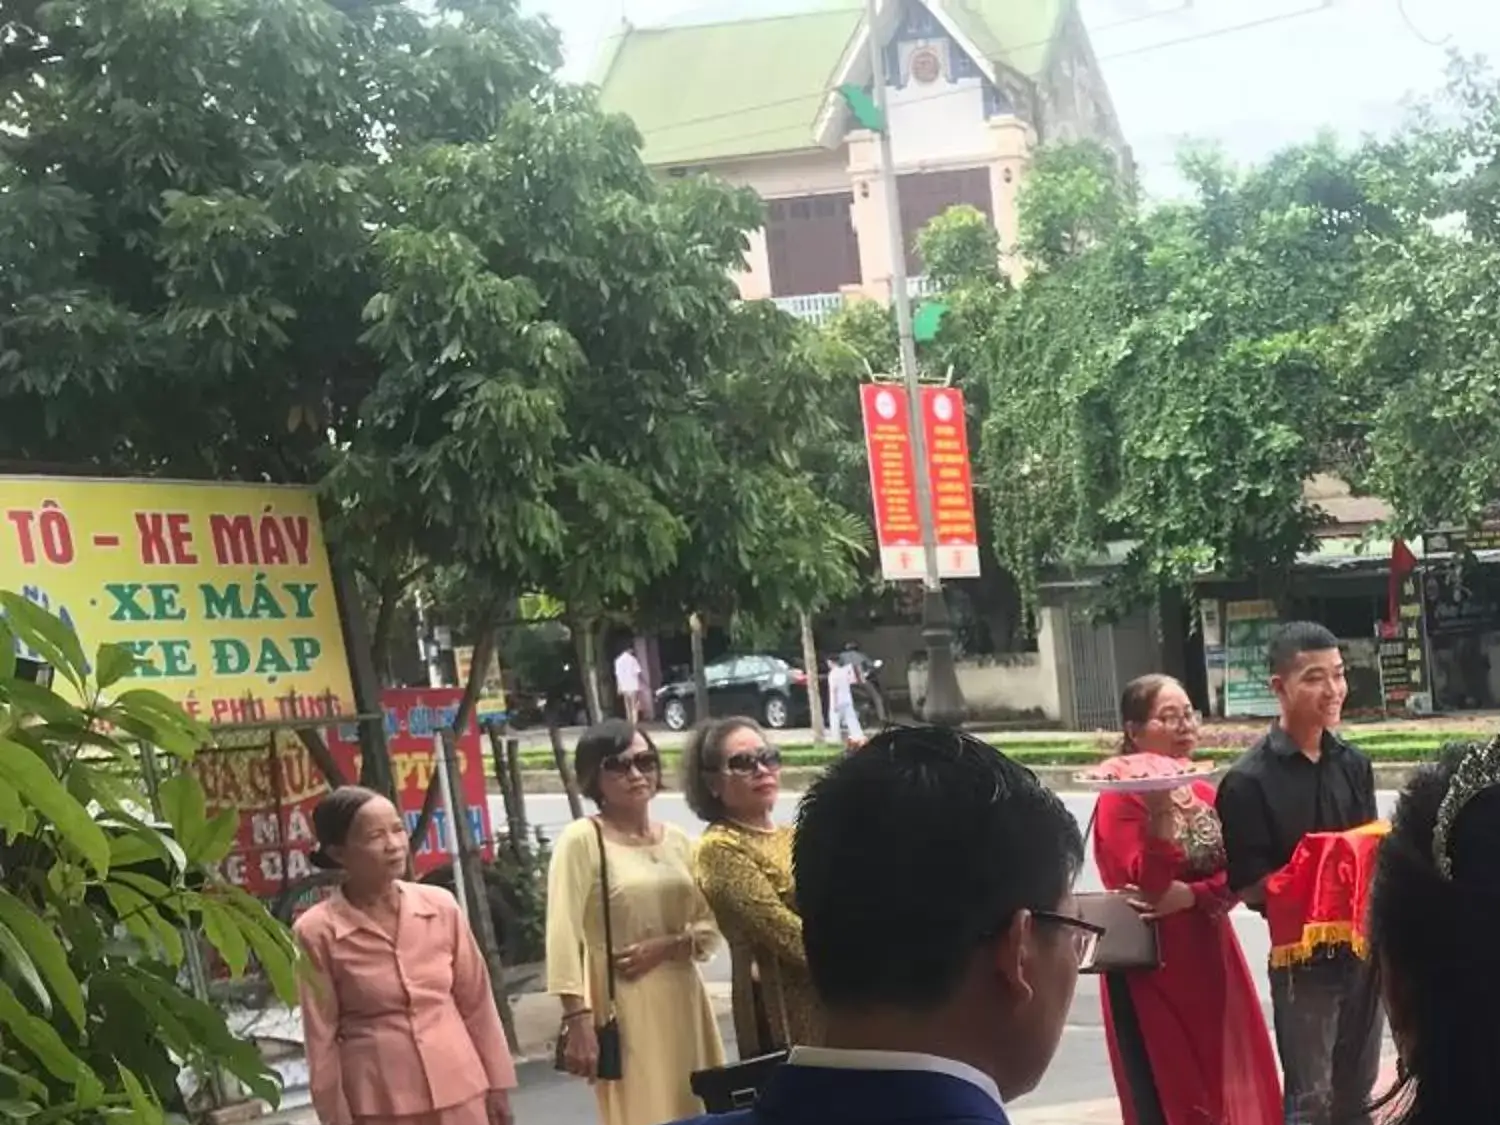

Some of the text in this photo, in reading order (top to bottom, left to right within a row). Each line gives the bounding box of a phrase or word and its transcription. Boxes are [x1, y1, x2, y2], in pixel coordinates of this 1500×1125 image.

[7, 499, 76, 565] TÔ
[135, 512, 198, 565] XE
[208, 504, 311, 565] MÁY
[104, 572, 319, 621] XE MÁY
[210, 637, 322, 684] ĐẠP
